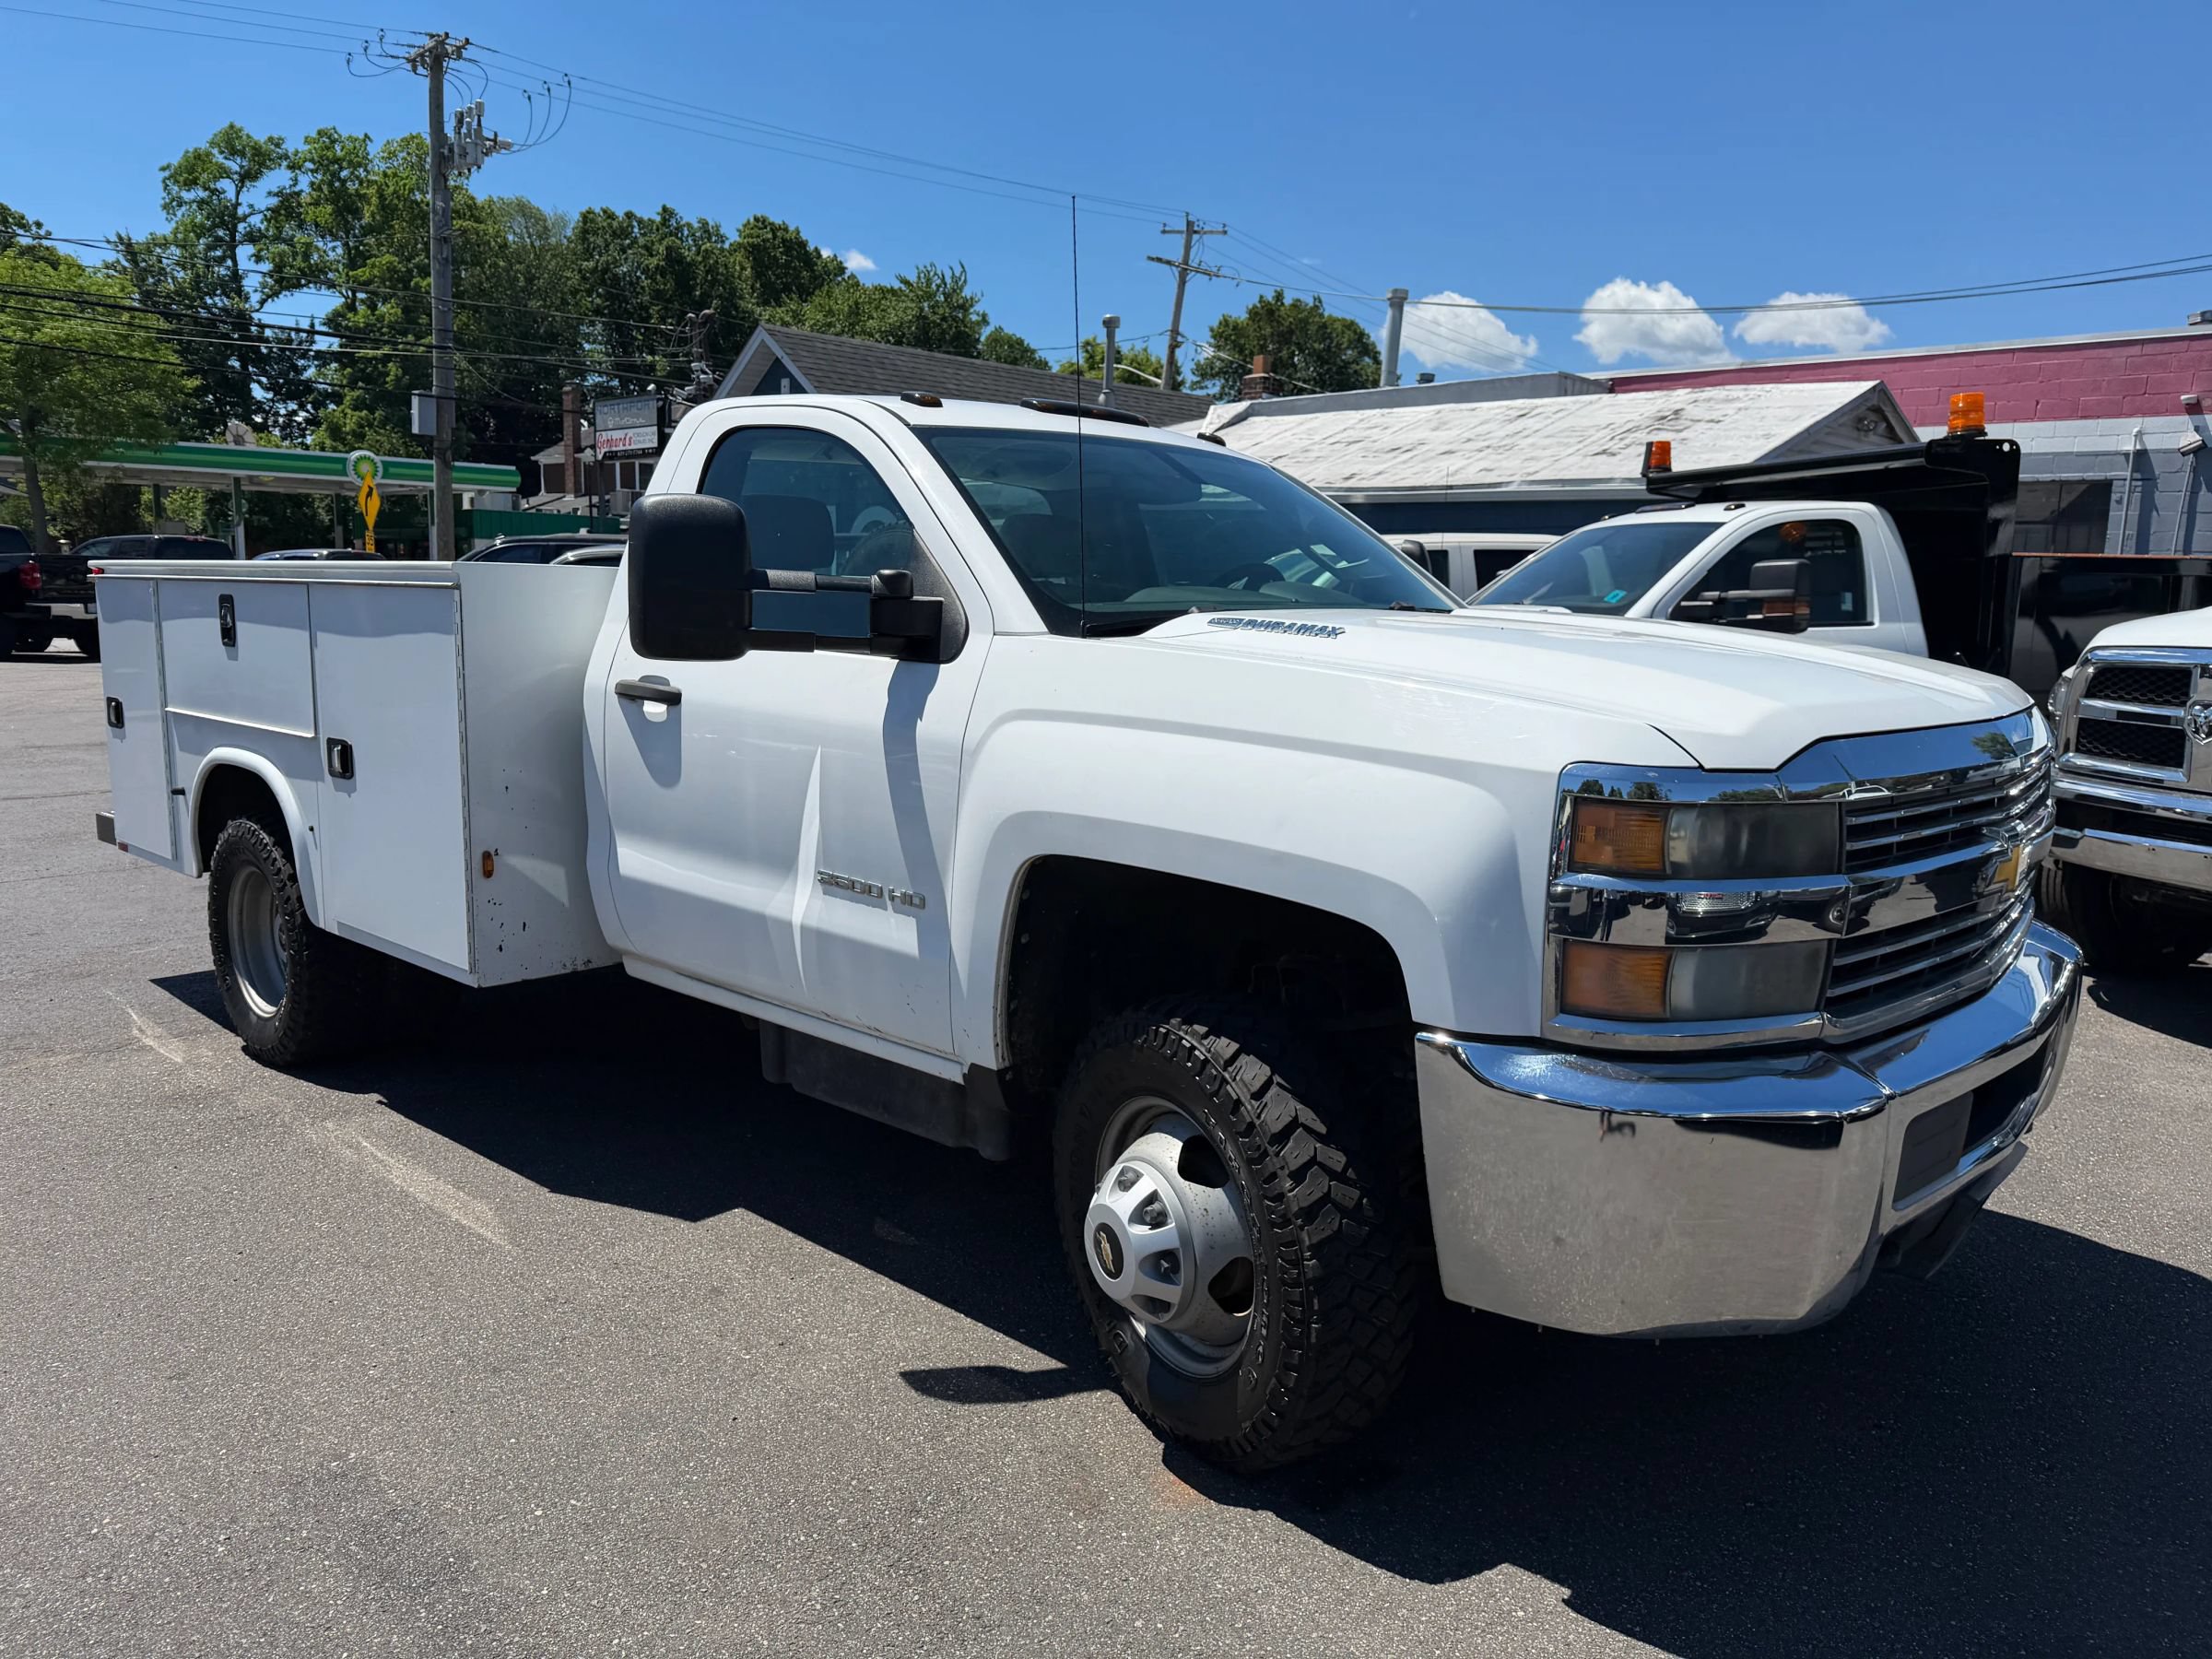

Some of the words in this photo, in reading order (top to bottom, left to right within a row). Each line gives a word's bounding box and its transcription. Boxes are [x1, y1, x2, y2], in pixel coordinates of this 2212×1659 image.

[596, 399, 656, 415] NORTHPORT
[1241, 618, 1346, 639] DURAMAX
[888, 886, 925, 910] HD
